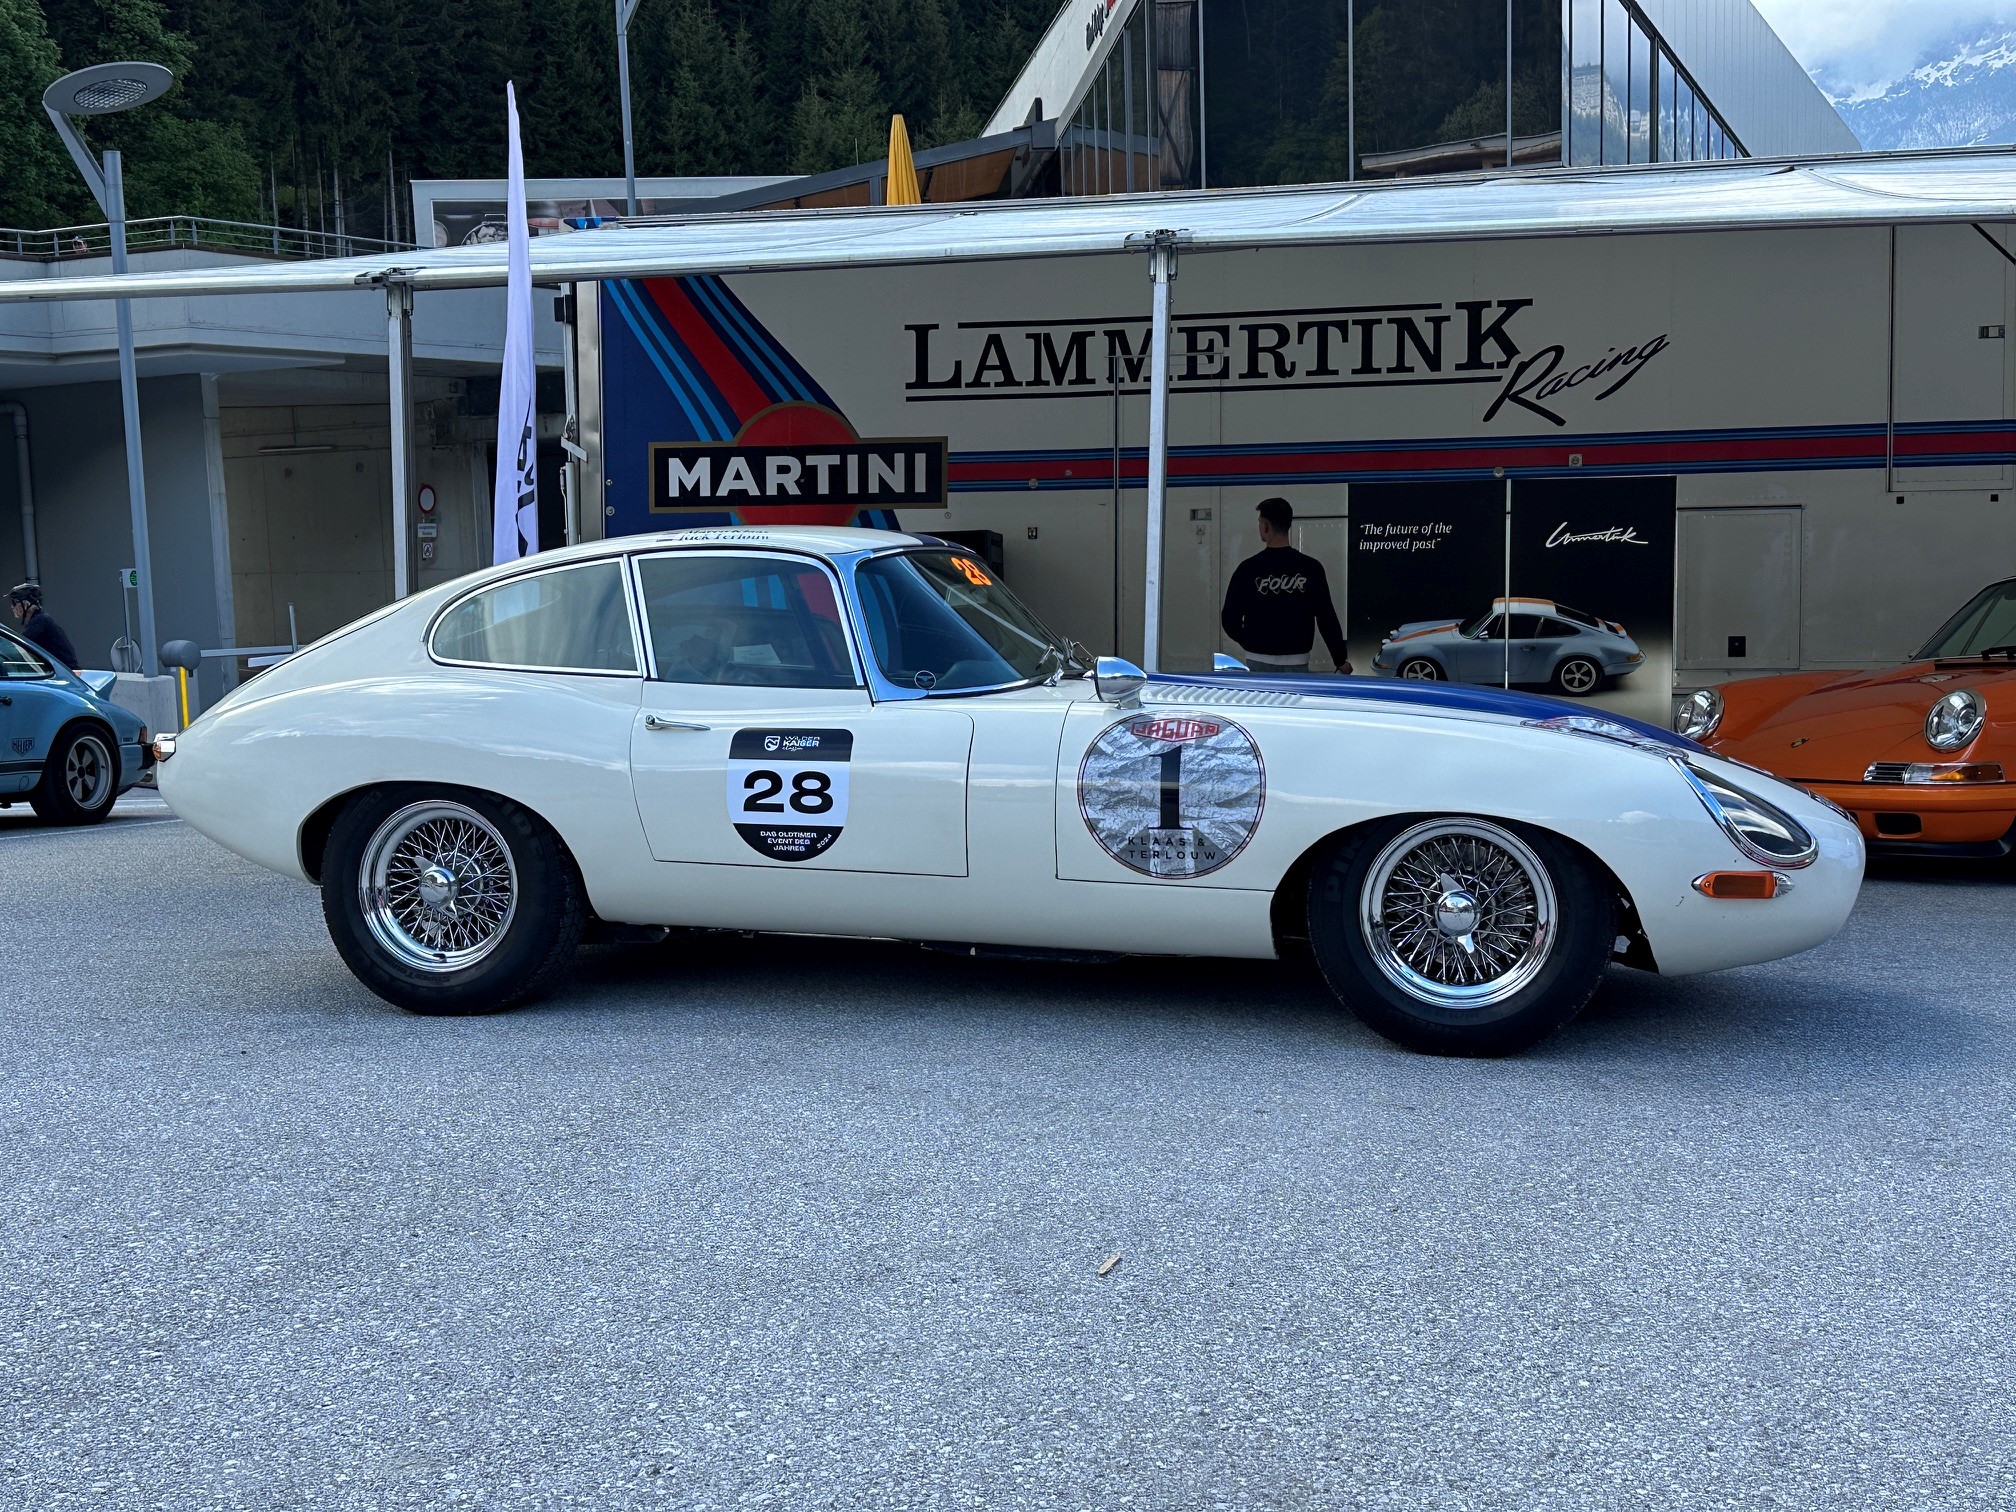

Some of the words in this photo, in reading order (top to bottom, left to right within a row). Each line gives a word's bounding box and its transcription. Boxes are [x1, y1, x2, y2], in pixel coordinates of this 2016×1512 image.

[904, 298, 1533, 391] LAMMERTINK
[1483, 333, 1670, 426] Racing
[668, 453, 927, 498] MARTINI
[1385, 523, 1419, 537] future
[1421, 523, 1434, 536] of
[1434, 522, 1452, 534] the
[1359, 538, 1410, 553] improved
[950, 557, 992, 586] 28
[1256, 574, 1307, 594] FOUR
[1134, 719, 1217, 740] JAGUAR
[743, 769, 834, 815] 28
[1148, 745, 1193, 830] 1
[760, 830, 777, 838] DAS
[778, 831, 818, 839] OLDTIMER
[1128, 836, 1186, 847] KLAAS
[1197, 838, 1206, 847] &
[1129, 850, 1217, 860] TERLOUW
